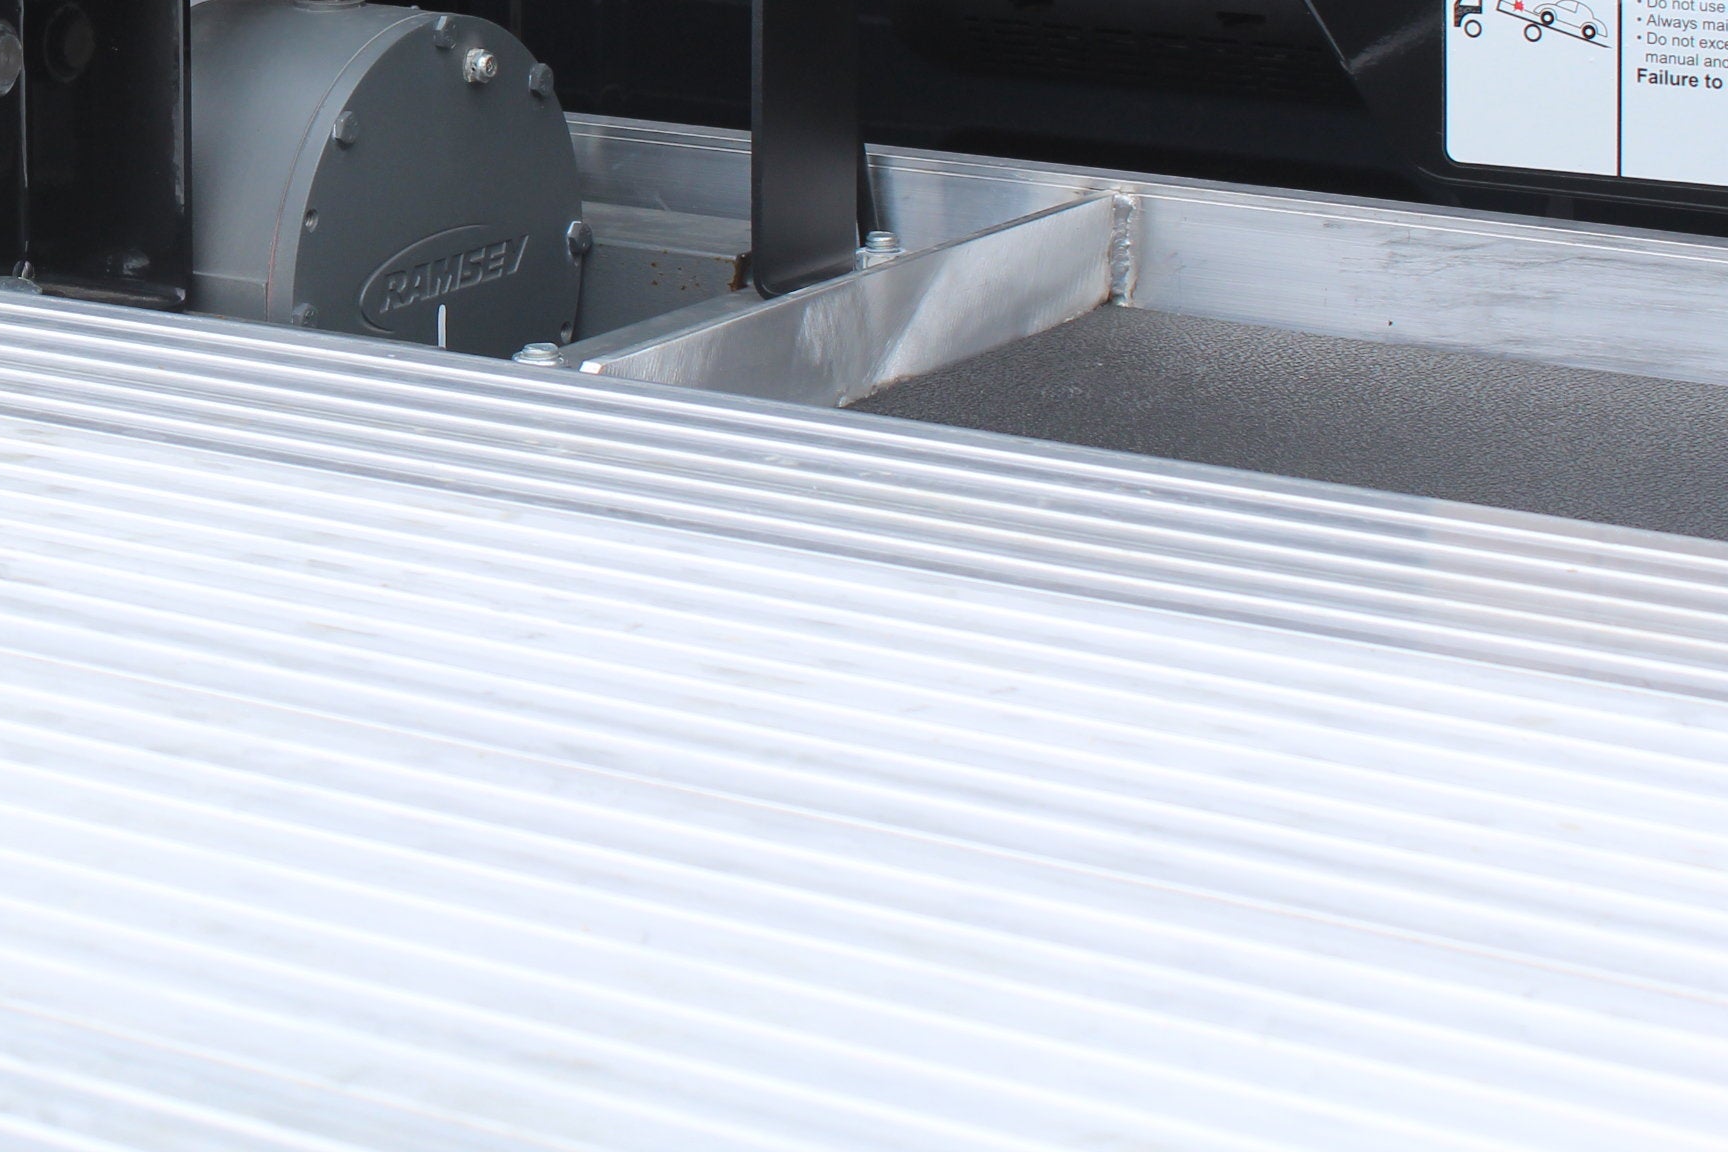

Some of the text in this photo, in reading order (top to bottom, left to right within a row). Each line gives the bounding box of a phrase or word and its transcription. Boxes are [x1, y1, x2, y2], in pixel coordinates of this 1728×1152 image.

[1699, 1, 1725, 13] use
[1647, 14, 1697, 32] Always
[1647, 32, 1667, 46] Do
[1672, 34, 1695, 48] not
[1645, 52, 1699, 66] manual
[1637, 68, 1723, 89] Failure to
[380, 234, 529, 314] RAMSEY
